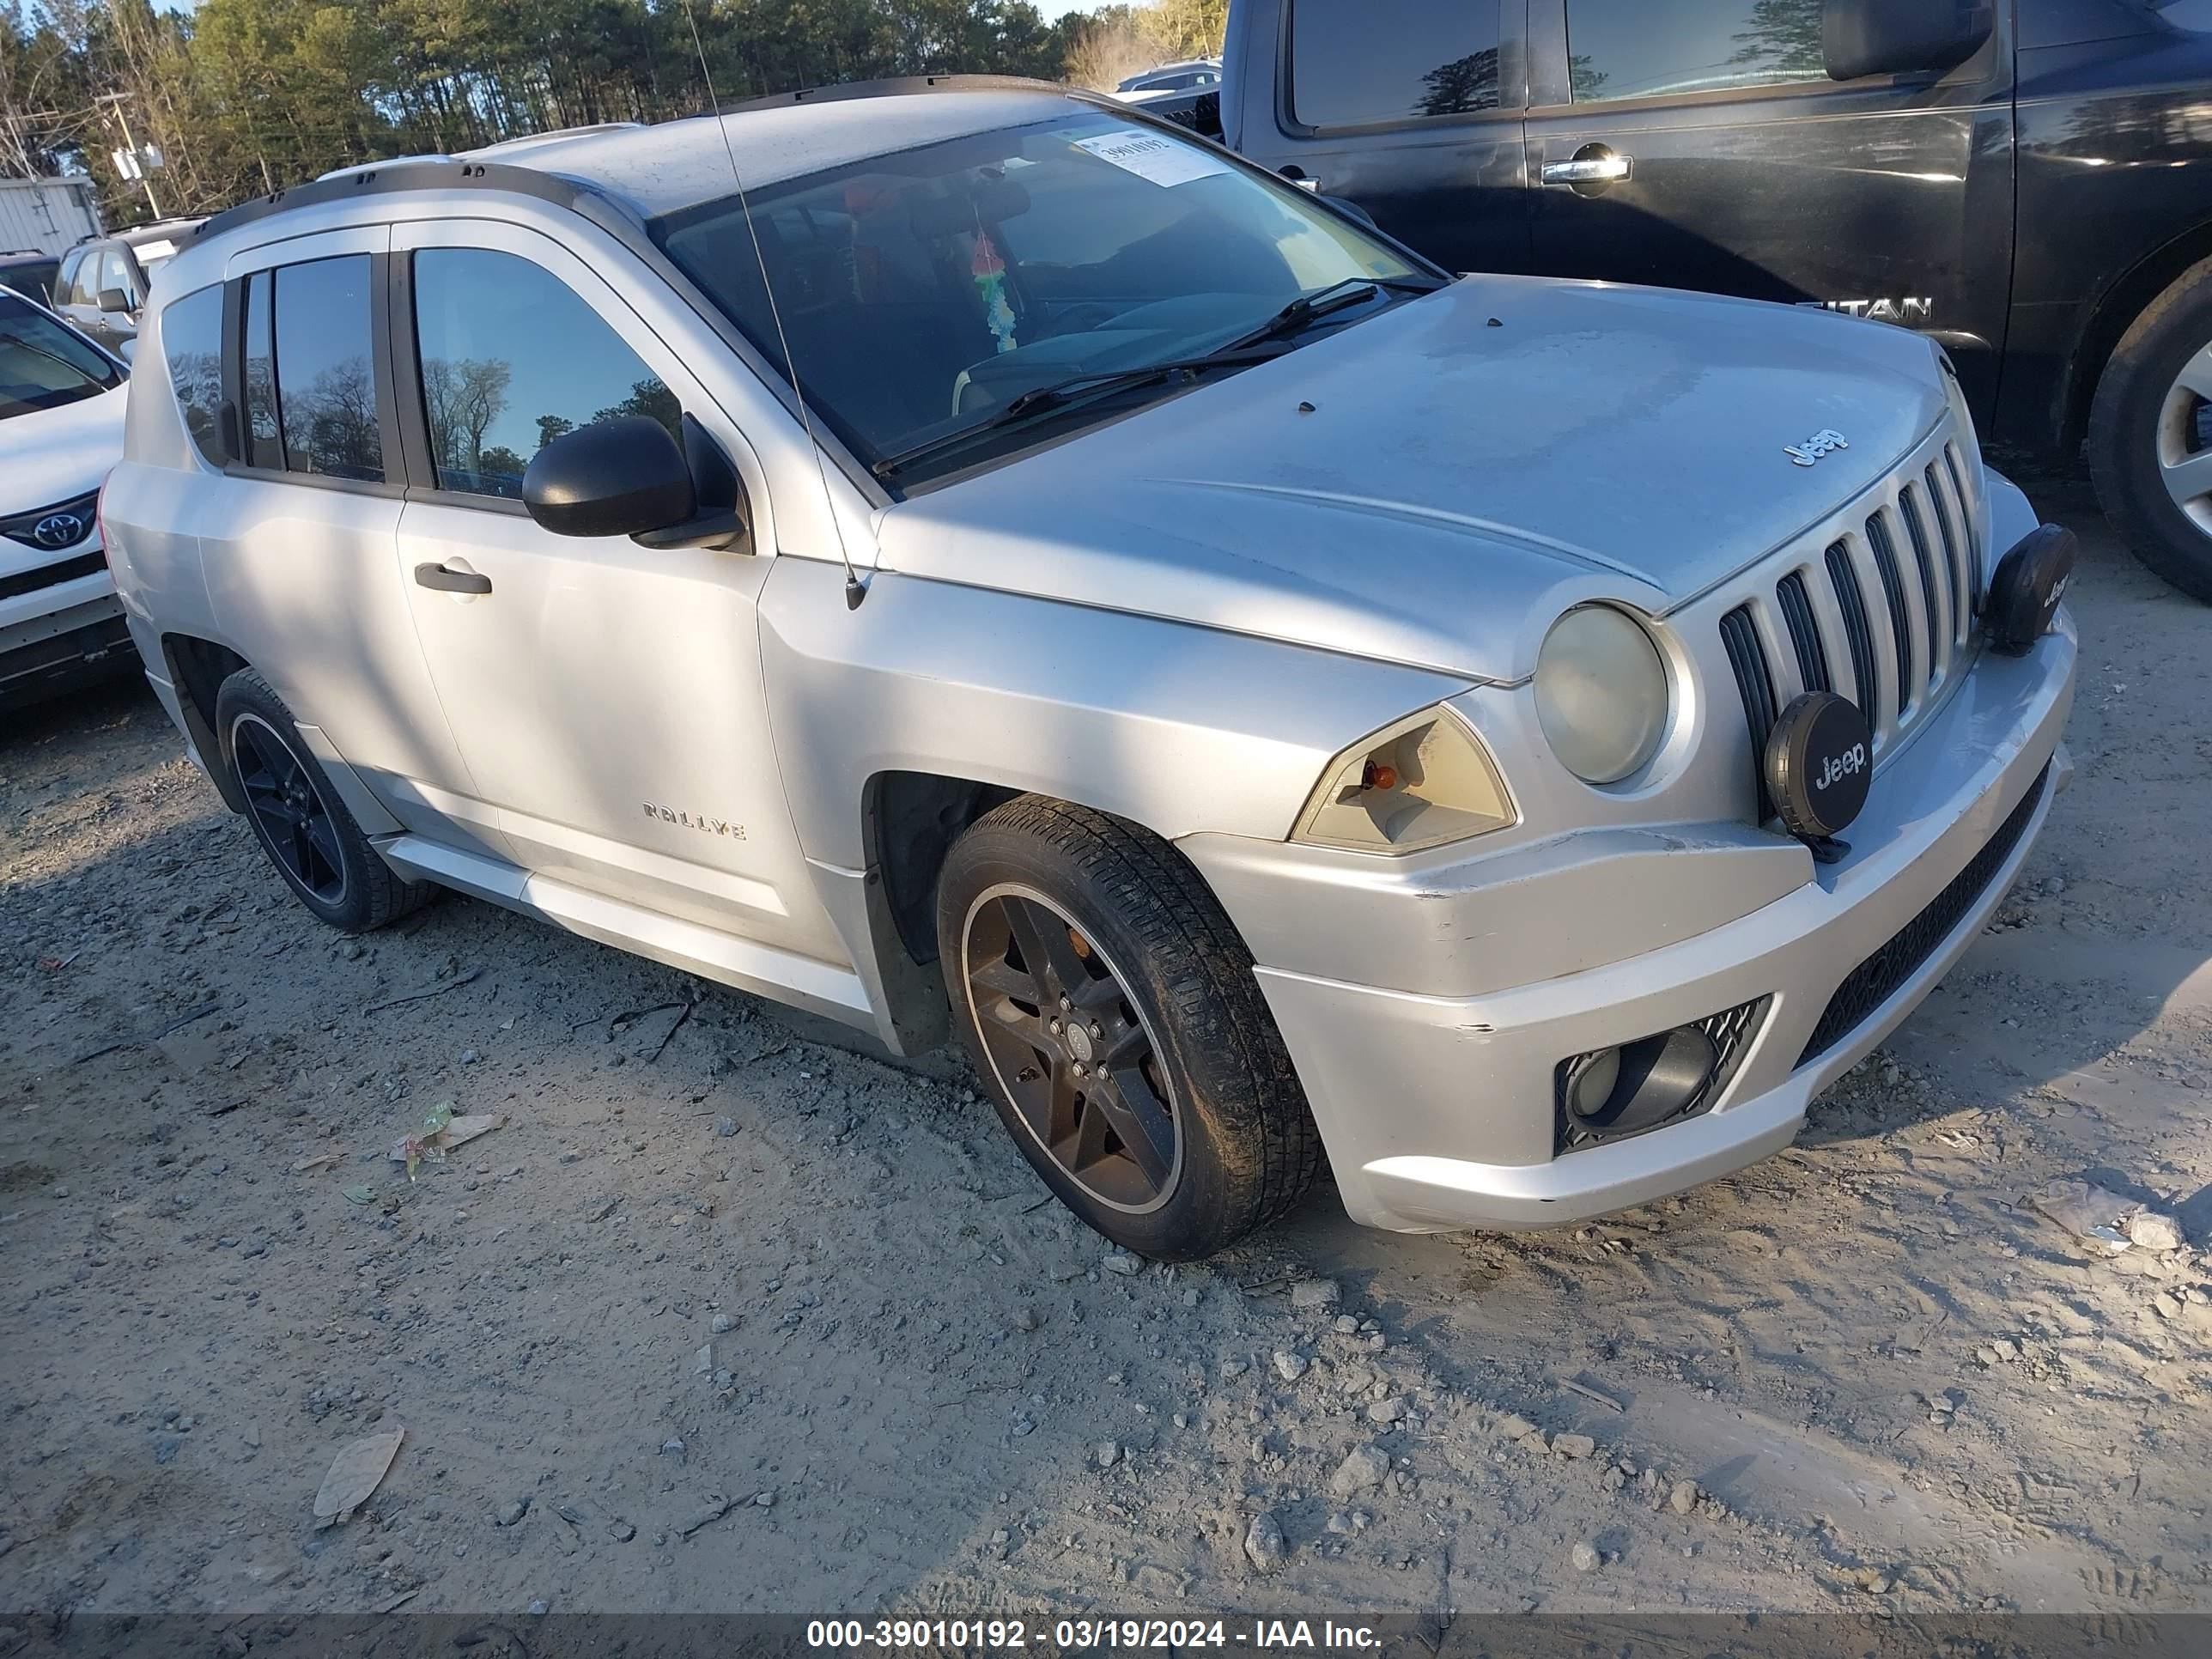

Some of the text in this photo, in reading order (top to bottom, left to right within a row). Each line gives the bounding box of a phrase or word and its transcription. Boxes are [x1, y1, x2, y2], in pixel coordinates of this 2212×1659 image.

[1783, 428, 1849, 466] Jeep
[1815, 742, 1866, 790] Jeep
[642, 800, 747, 841] RALLYE
